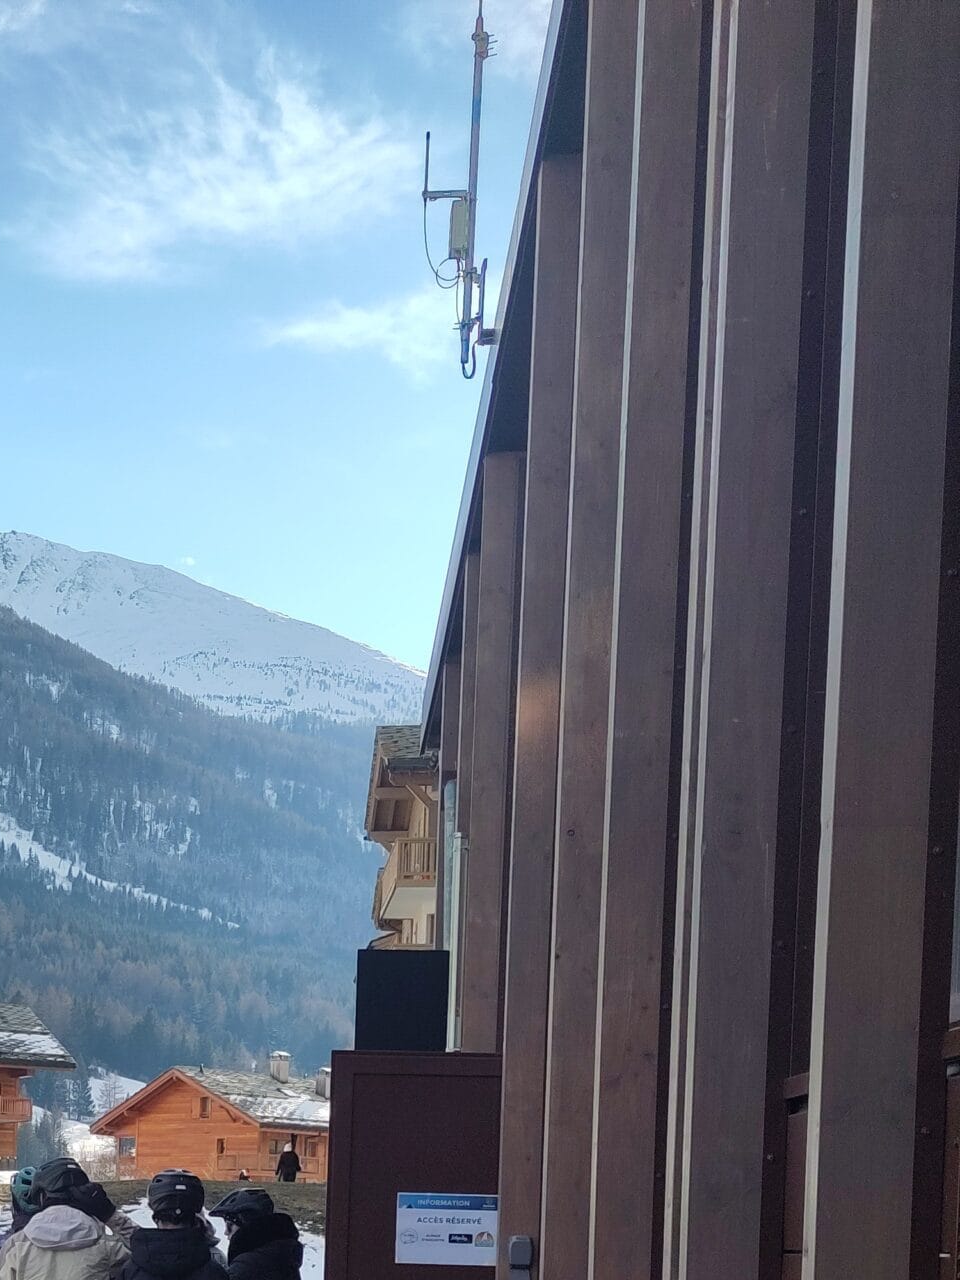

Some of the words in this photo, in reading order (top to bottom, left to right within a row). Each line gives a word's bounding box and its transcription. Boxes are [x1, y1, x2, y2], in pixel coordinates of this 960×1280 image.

[417, 1199, 471, 1207] INFORMATION
[416, 1215, 444, 1225] ACCÈS
[445, 1215, 483, 1226] RÉSERVÉ
